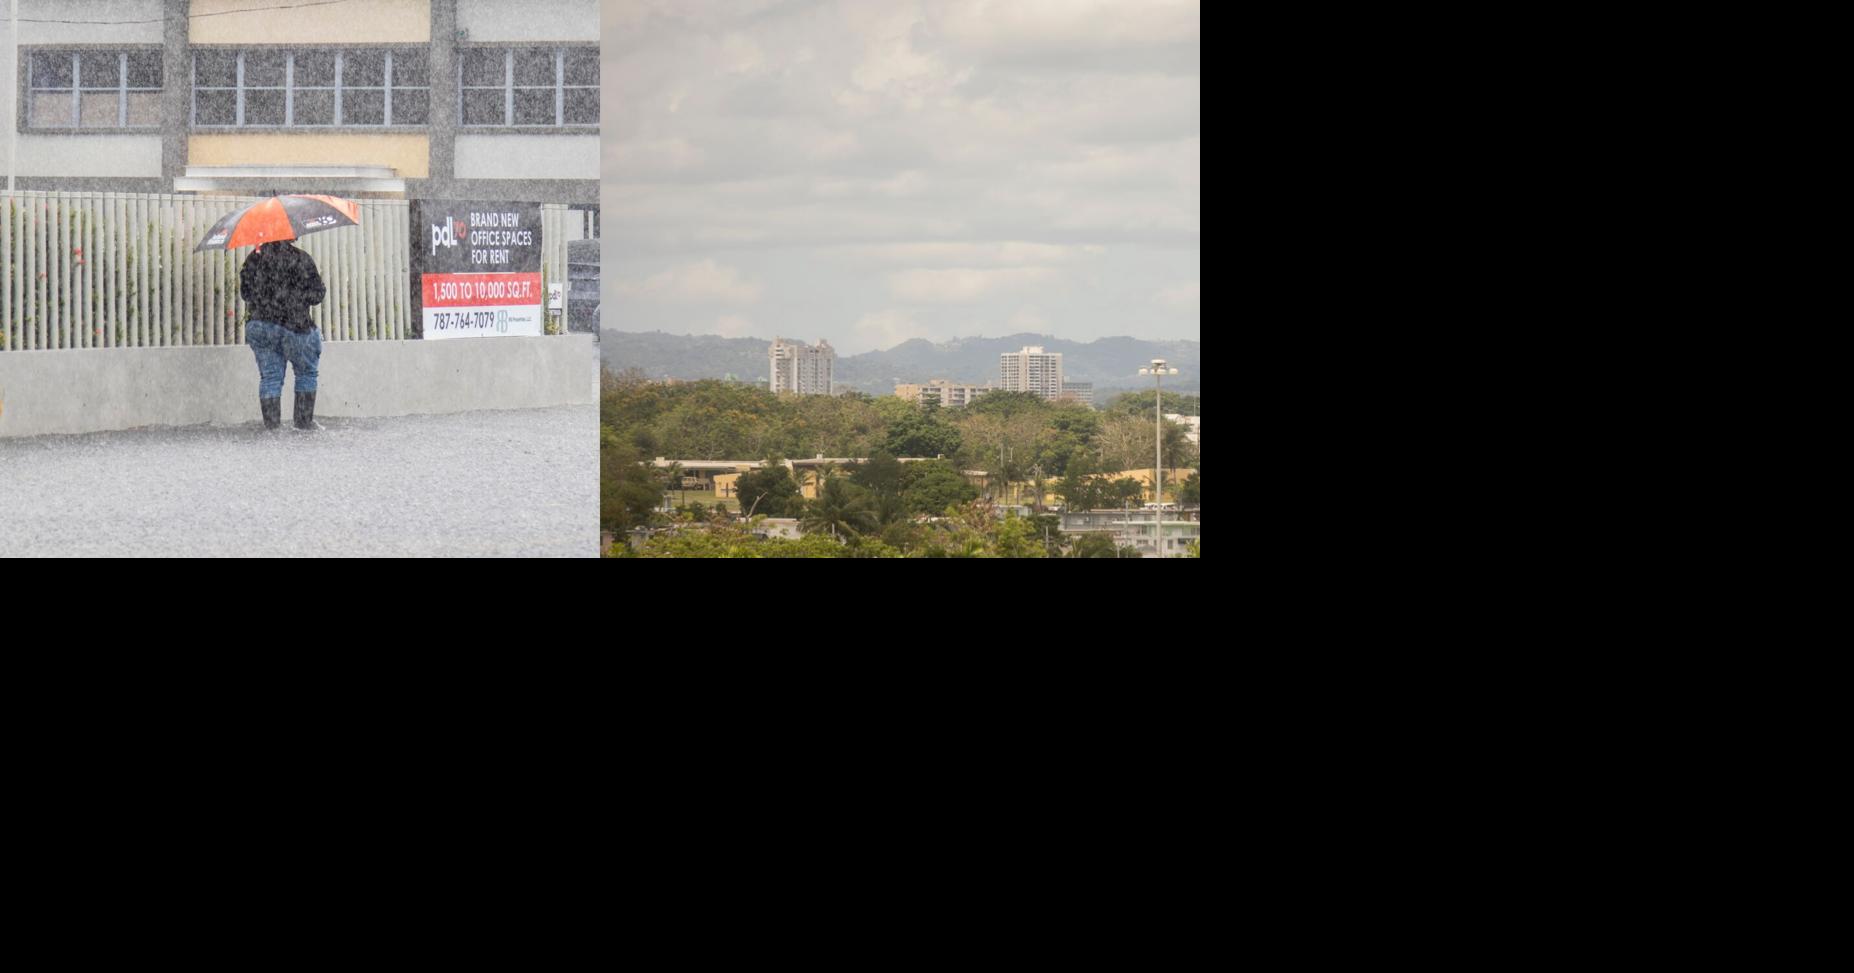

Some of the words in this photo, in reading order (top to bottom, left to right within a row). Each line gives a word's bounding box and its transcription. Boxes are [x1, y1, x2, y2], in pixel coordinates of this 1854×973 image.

[470, 212, 499, 227] BRAND
[501, 212, 519, 228] NEW
[471, 230, 500, 246] OFFICE
[501, 231, 532, 246] SPACES
[471, 249, 488, 264] FOR
[490, 249, 509, 264] RENT
[433, 282, 458, 302] 1,500
[460, 282, 473, 299] TO
[475, 281, 505, 300] 10,000
[507, 281, 533, 299] SQ.FT.
[433, 311, 495, 330] 787-764-7079
